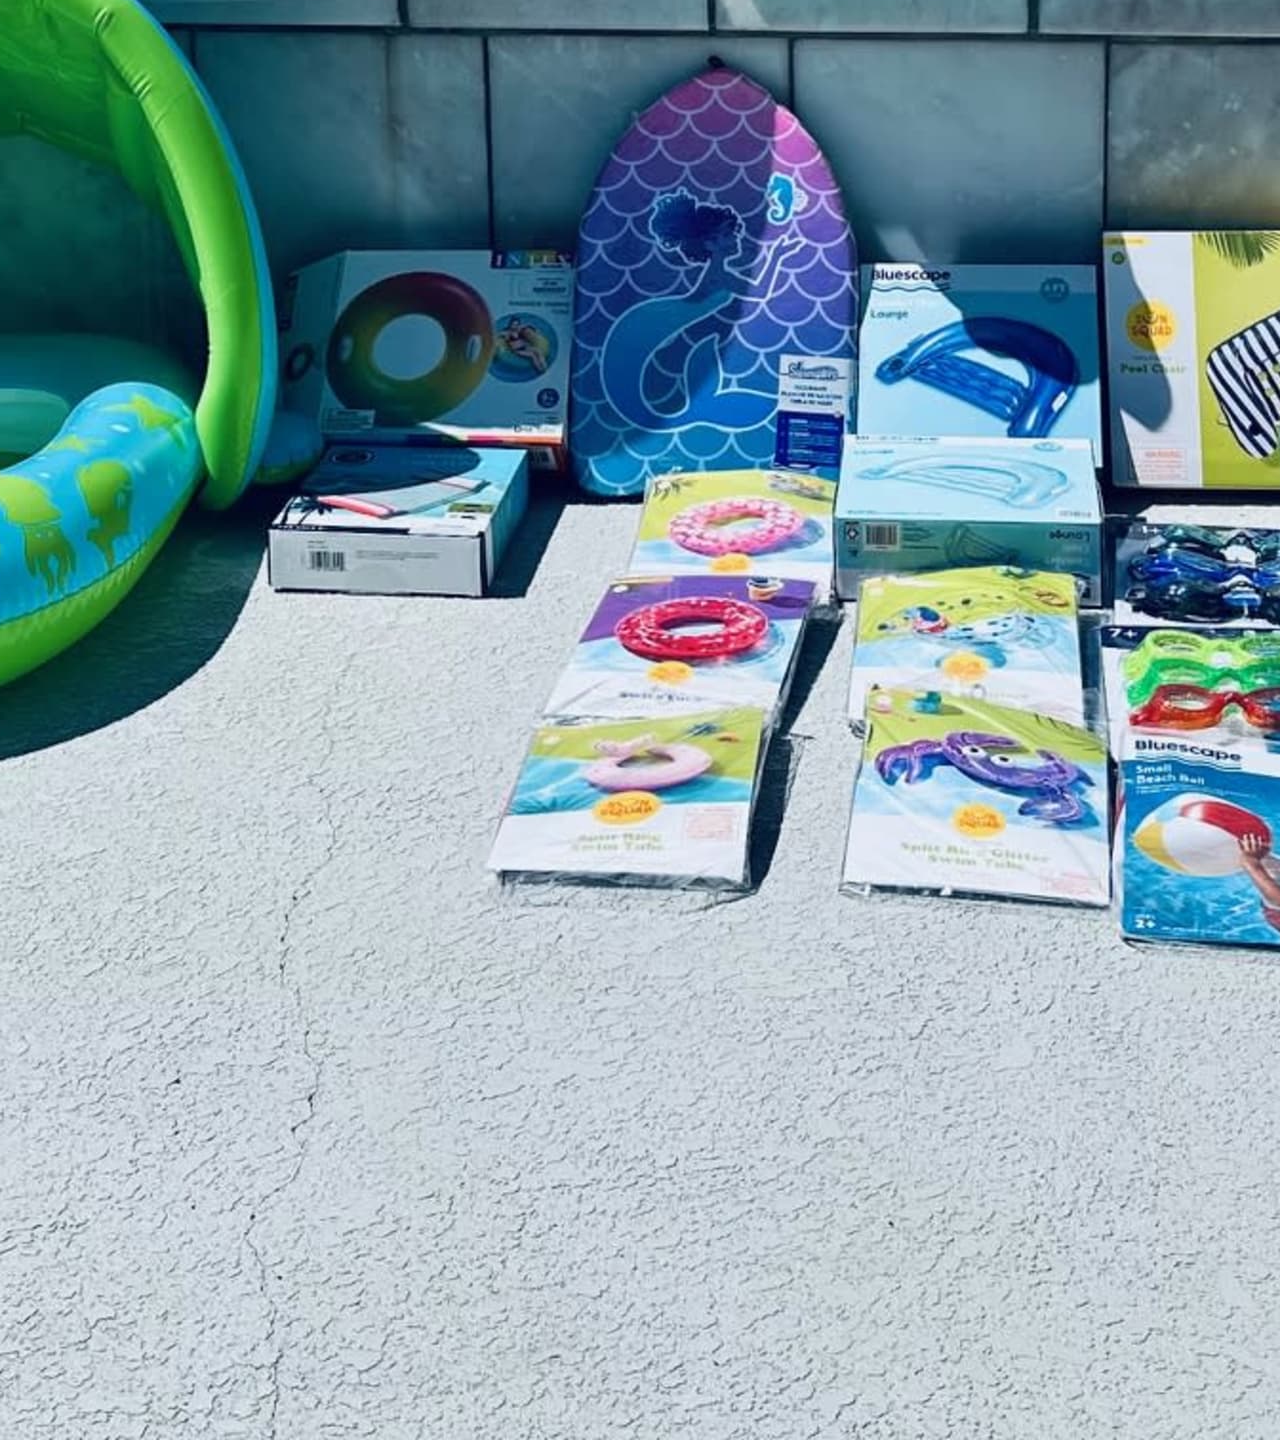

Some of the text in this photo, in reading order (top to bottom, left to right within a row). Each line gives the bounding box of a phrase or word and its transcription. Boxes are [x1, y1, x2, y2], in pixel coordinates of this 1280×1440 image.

[871, 269, 951, 284] Bluescape
[871, 310, 909, 321] Lounge
[1134, 738, 1244, 763] Bluescape
[1135, 763, 1173, 775] Small
[1135, 773, 1206, 786] Beach Ball
